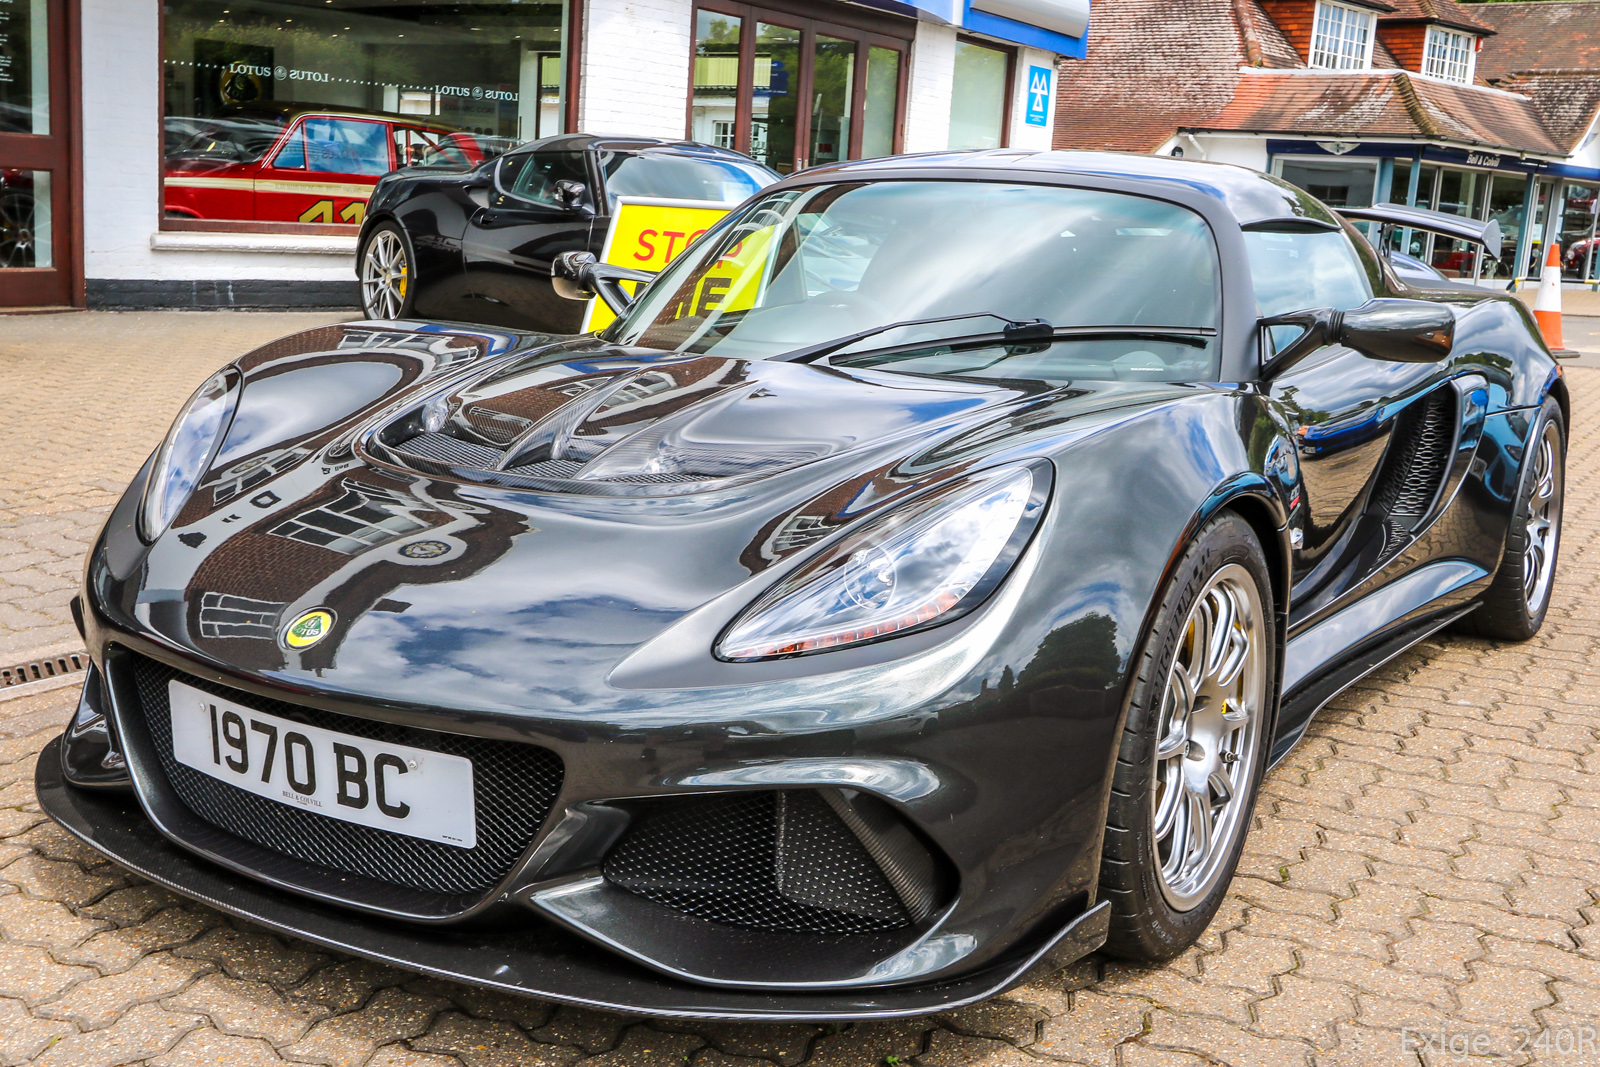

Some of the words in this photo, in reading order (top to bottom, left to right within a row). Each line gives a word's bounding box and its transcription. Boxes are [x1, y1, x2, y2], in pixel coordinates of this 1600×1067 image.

[229, 63, 271, 77] LOTUS
[435, 80, 470, 97] LOTUS
[1467, 154, 1479, 164] Bell
[1477, 156, 1483, 165] &
[209, 703, 317, 796] 1970
[332, 741, 411, 819] BC
[282, 790, 295, 800] BELL
